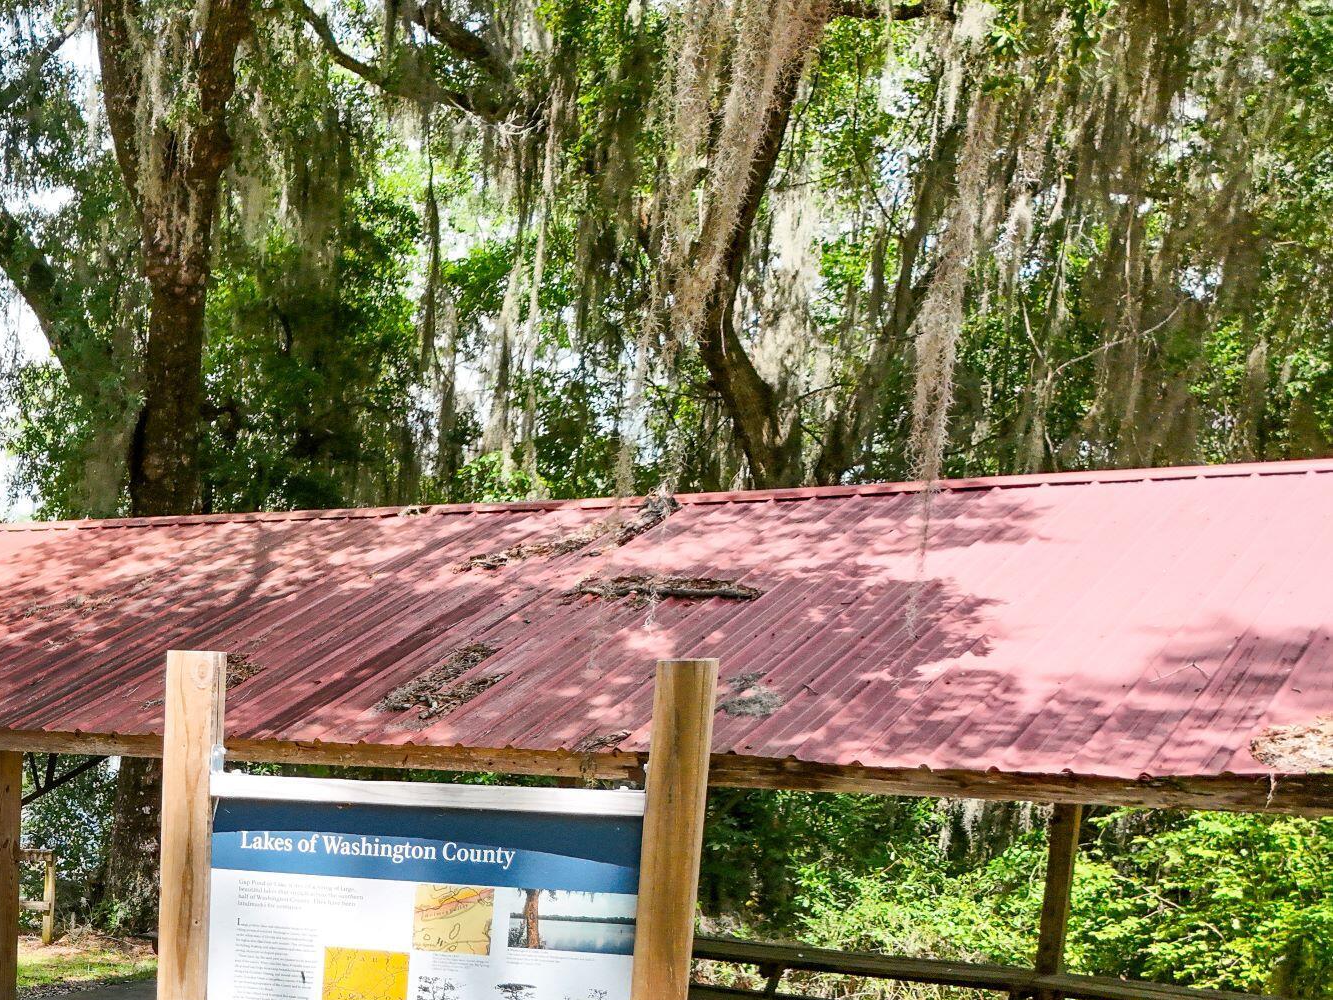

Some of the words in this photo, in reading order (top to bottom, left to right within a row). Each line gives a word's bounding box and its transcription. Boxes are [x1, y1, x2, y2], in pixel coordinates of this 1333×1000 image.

[240, 830, 293, 852] Lakes
[297, 833, 321, 853] of
[322, 834, 437, 864] Washington
[442, 841, 516, 870] County
